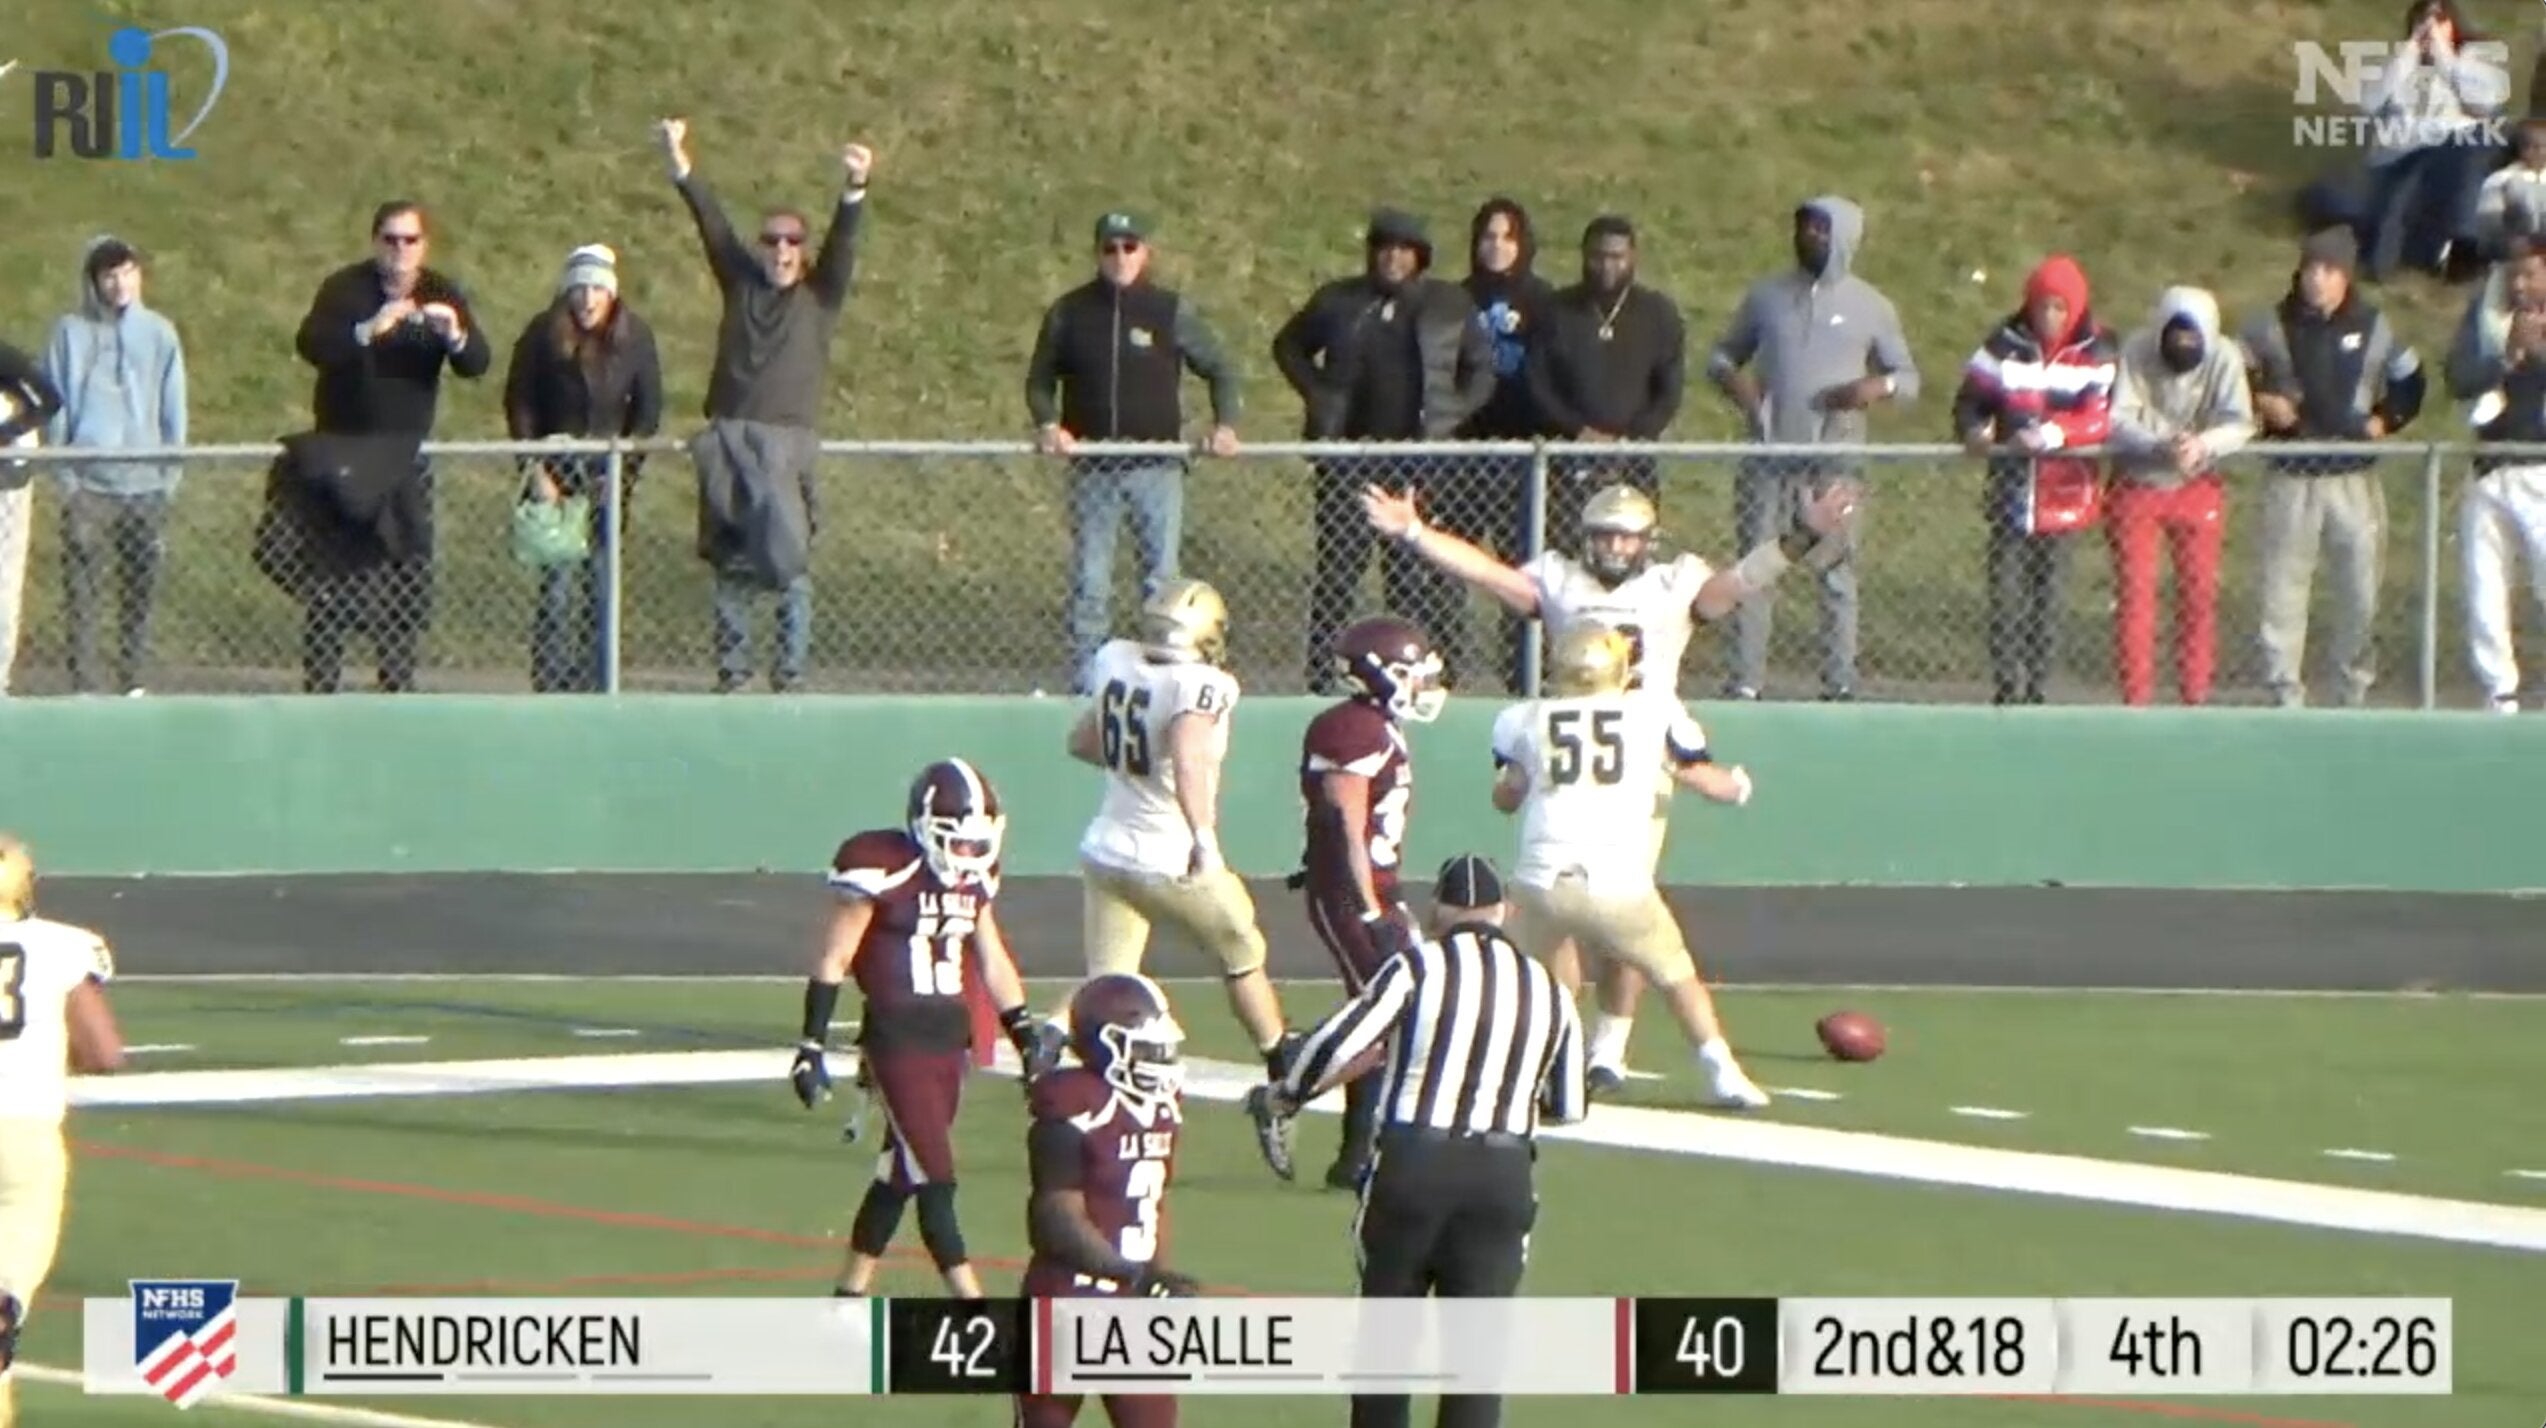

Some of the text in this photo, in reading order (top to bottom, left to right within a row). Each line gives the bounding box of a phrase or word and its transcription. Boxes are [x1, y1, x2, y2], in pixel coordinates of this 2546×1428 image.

[1103, 679, 1150, 776] 65
[1549, 710, 1624, 785] 55
[1120, 1159, 1166, 1262] 3
